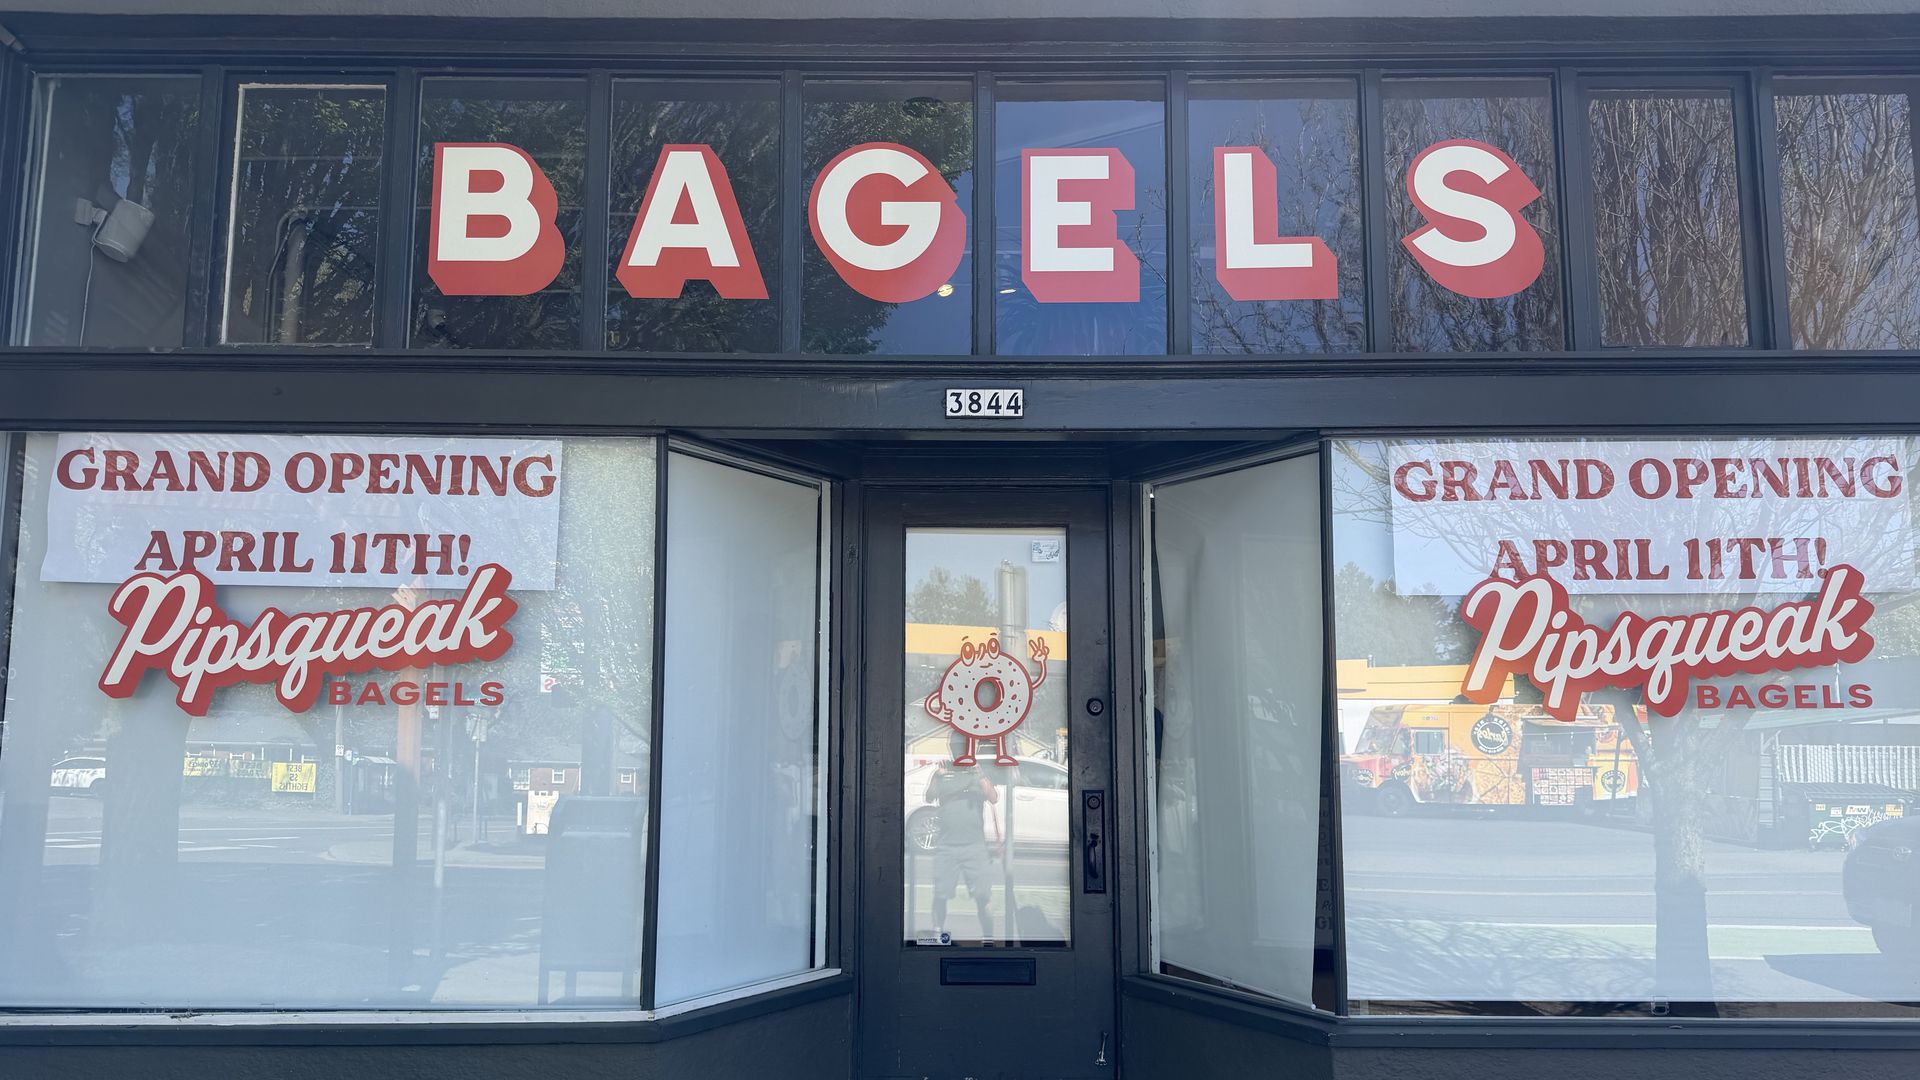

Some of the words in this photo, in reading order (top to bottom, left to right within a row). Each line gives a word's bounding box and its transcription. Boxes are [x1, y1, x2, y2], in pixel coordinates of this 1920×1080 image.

[428, 139, 1545, 303] BAGELS
[949, 391, 1022, 415] 3844
[56, 448, 270, 492] GRAND
[284, 451, 556, 498] OPENING
[1393, 459, 1615, 502] GRAND
[1628, 453, 1904, 499] OPENING
[134, 530, 314, 573] APRIL
[329, 532, 472, 576] 11TH!
[1489, 538, 1671, 581] APRIL
[1684, 536, 1829, 580] 11TH!
[100, 564, 513, 713] Pipsqueak
[1462, 564, 1870, 718] Pipsqueak
[328, 681, 505, 706] BAGELS
[1695, 684, 1874, 709] BAGELS
